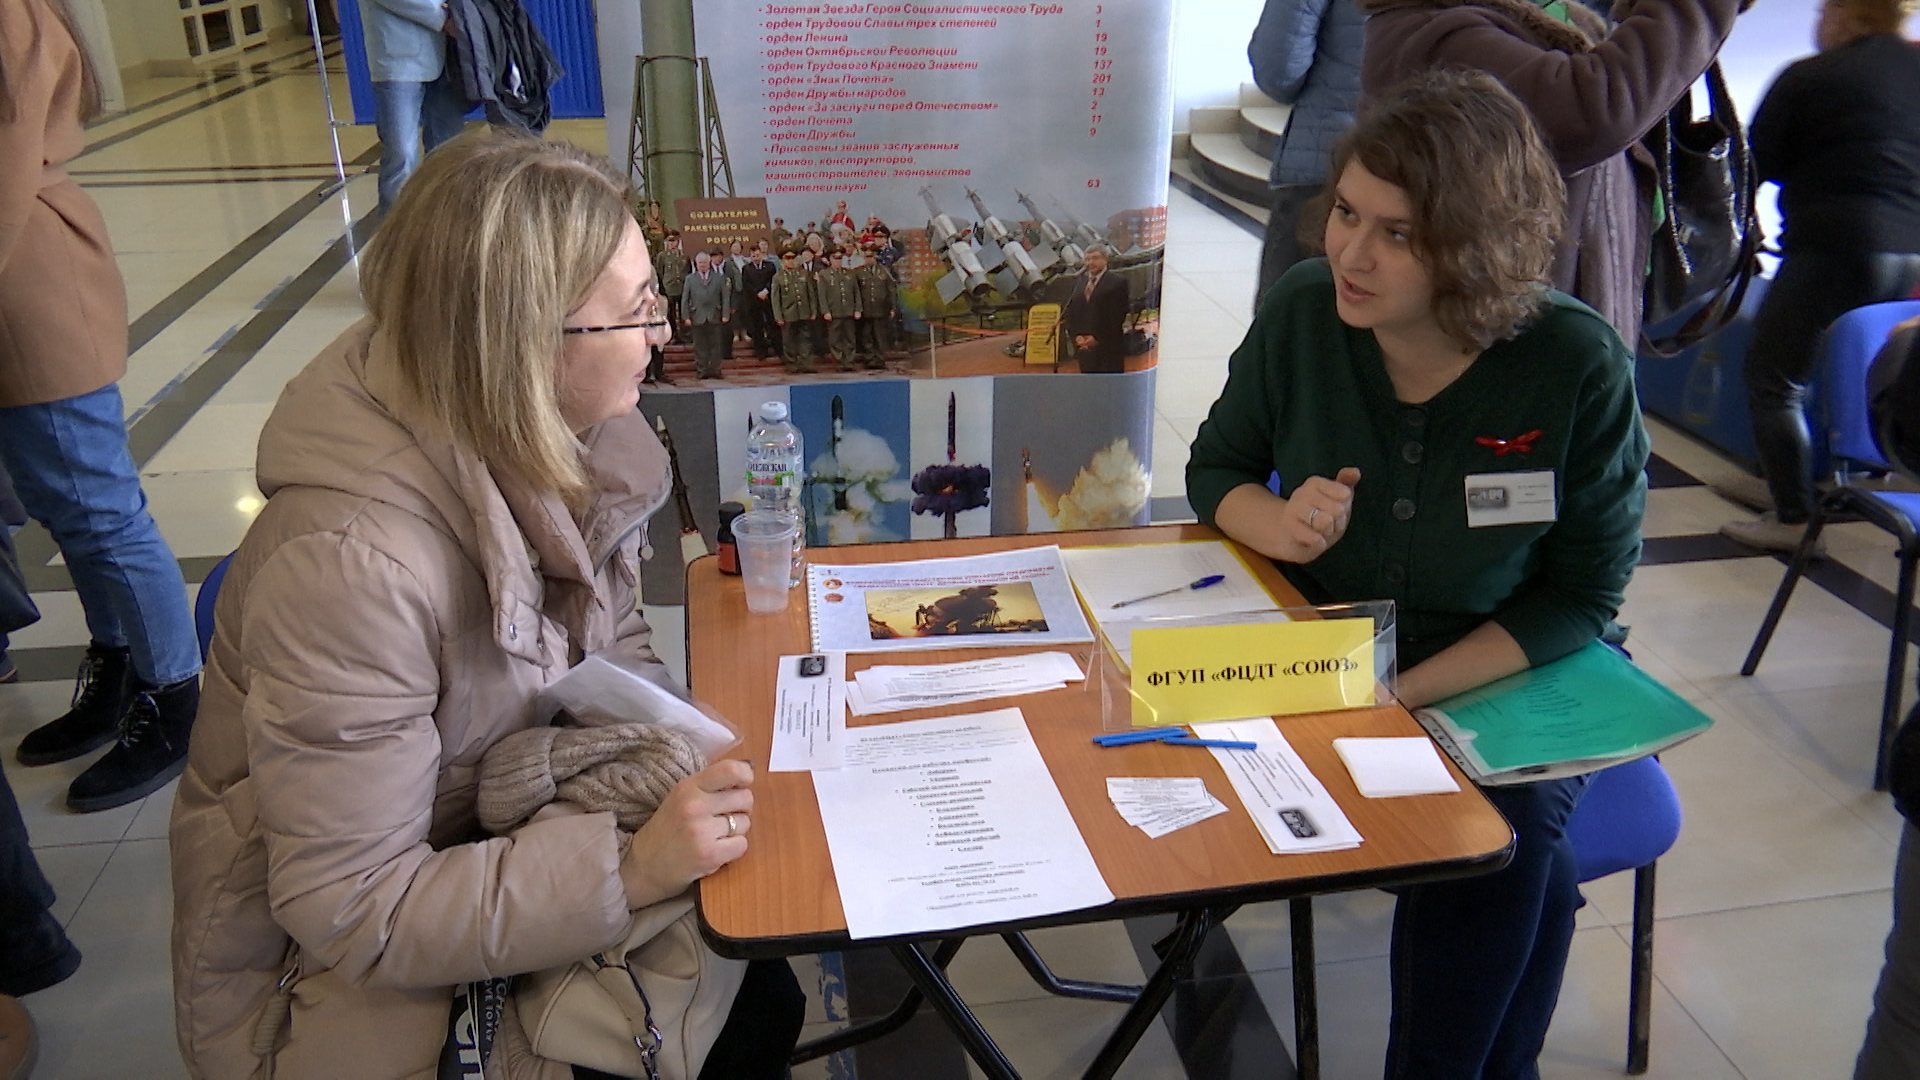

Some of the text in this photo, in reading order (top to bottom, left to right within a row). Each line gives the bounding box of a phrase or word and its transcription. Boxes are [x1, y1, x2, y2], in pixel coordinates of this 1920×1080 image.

[765, 3, 1063, 16] Золотая Звезда Героя Социалистического Труда
[1096, 5, 1102, 14] 3
[766, 18, 997, 30] орден Трудовой Славы трех степеней
[1096, 19, 1101, 28] 1
[766, 32, 848, 45] орден Ленина
[1096, 32, 1108, 42] 19
[766, 45, 958, 59] орден Октябрьской Революции
[1094, 47, 1107, 56] 19
[768, 60, 978, 74] орден Трудового Красного Знамени
[1093, 60, 1113, 70] 137
[768, 74, 894, 87] орден «Знак Почета»
[1092, 74, 1112, 84] 201
[768, 88, 906, 101] орден Дружбы народов
[1092, 87, 1105, 97] 13
[769, 101, 999, 116] орден «За заслуги перед Отечеством»
[1091, 101, 1098, 110] 2
[770, 116, 853, 129] орден Почета
[1091, 114, 1102, 124] 11
[770, 130, 856, 142] орден Дружбы
[1090, 128, 1097, 137] 9
[770, 144, 838, 156] Присвоены
[883, 143, 959, 154] заслуженных
[892, 168, 972, 178] экономистов
[766, 182, 868, 194] и деятелей науки
[1087, 178, 1101, 188] 63
[690, 210, 758, 219] СОЗДАТЕЛЯМ
[684, 224, 737, 232] РАКЕТНОГО
[1147, 657, 1358, 687] ФГУП «ФЦДТ «СОЮЗ»
